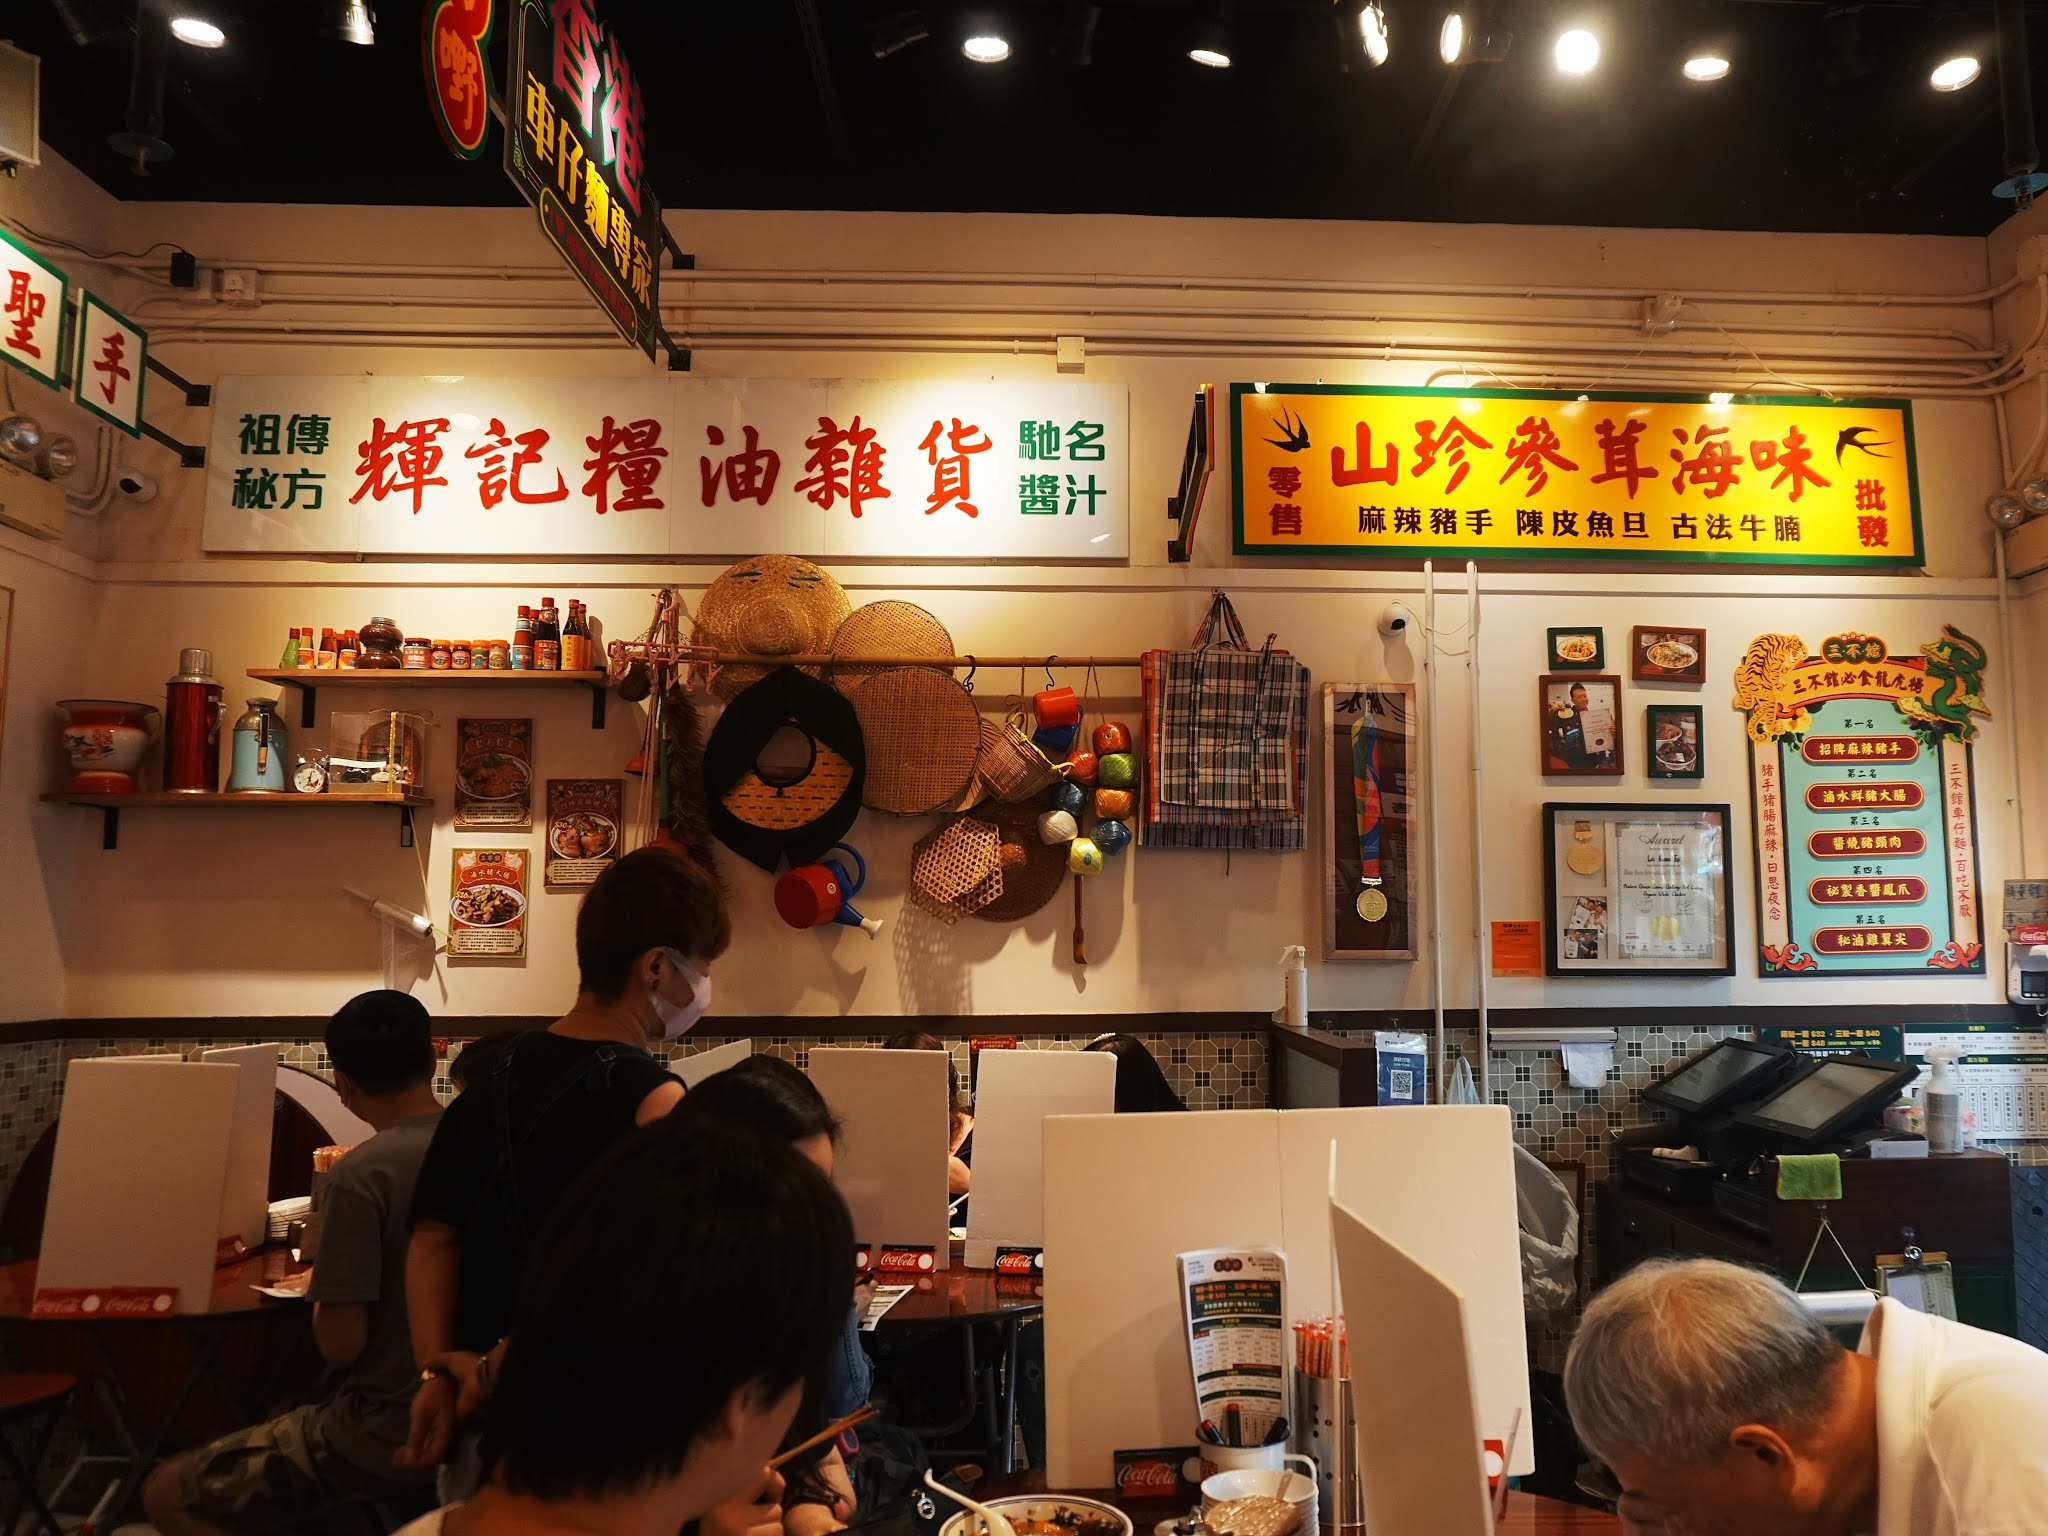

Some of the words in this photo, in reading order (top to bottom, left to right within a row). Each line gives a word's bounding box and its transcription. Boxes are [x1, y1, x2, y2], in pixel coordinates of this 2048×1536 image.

[525, 70, 651, 311] 車仔麵專家
[238, 413, 331, 456] 祖傳
[1018, 419, 1106, 462] 馳名
[348, 414, 994, 520] 輝記糧油雜貨
[231, 467, 327, 511] 秘方
[1018, 473, 1107, 517] 醬汁
[1267, 465, 1302, 536] 零售
[1358, 505, 1494, 536] 麻辣豬手
[1515, 507, 1650, 539] 陳皮魚旦
[1670, 511, 1802, 543] 古法牛腩
[1855, 478, 1890, 548] 批發
[1844, 718, 1874, 729] 第一名
[1819, 741, 1902, 756] 招牌麻辣豬手
[1847, 768, 1877, 779] 第二名
[1850, 815, 1880, 826] 第三名
[1833, 835, 1902, 851] 醬燒豬頭肉
[1852, 865, 1883, 875] 第四名
[1855, 915, 1886, 925] 第五名
[880, 1252, 918, 1267] Coca-Cola
[996, 1252, 1034, 1269] Coca-Cola
[1117, 1463, 1178, 1487] Coca-Cola
